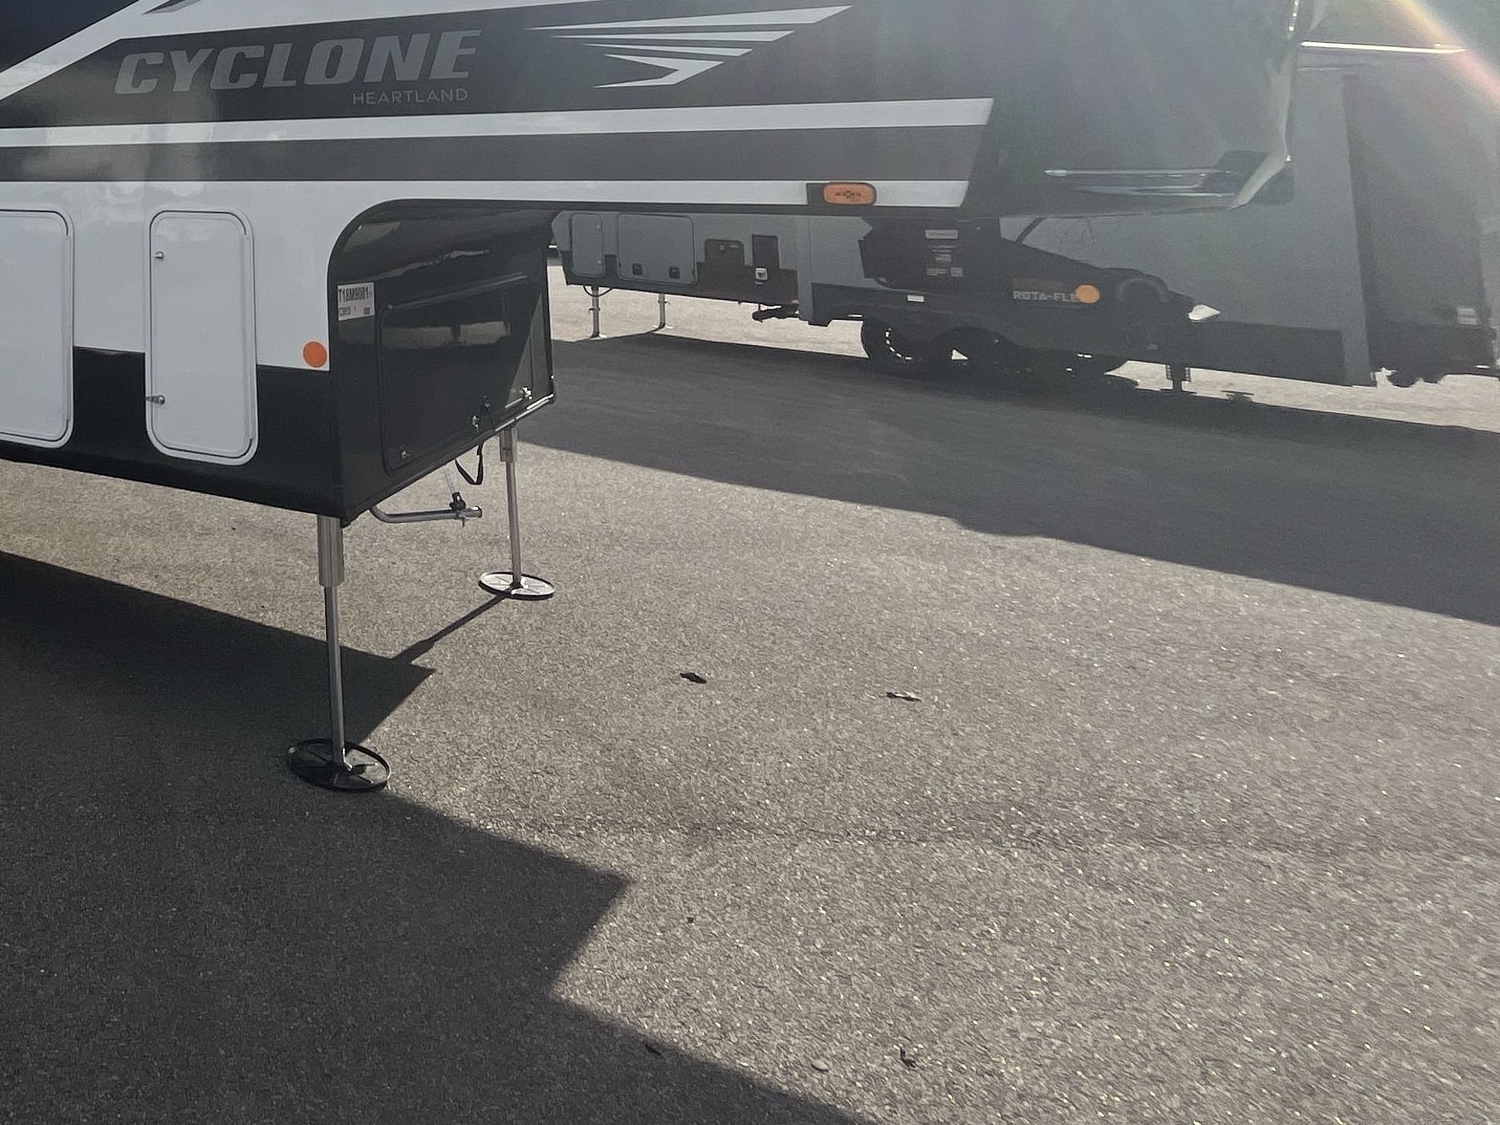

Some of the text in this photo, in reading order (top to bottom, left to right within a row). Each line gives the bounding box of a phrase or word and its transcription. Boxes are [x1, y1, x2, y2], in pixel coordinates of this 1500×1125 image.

[114, 29, 482, 95] CYCLONE
[352, 88, 468, 106] HEARTLAND
[1012, 290, 1078, 302] ROTA-FLE
